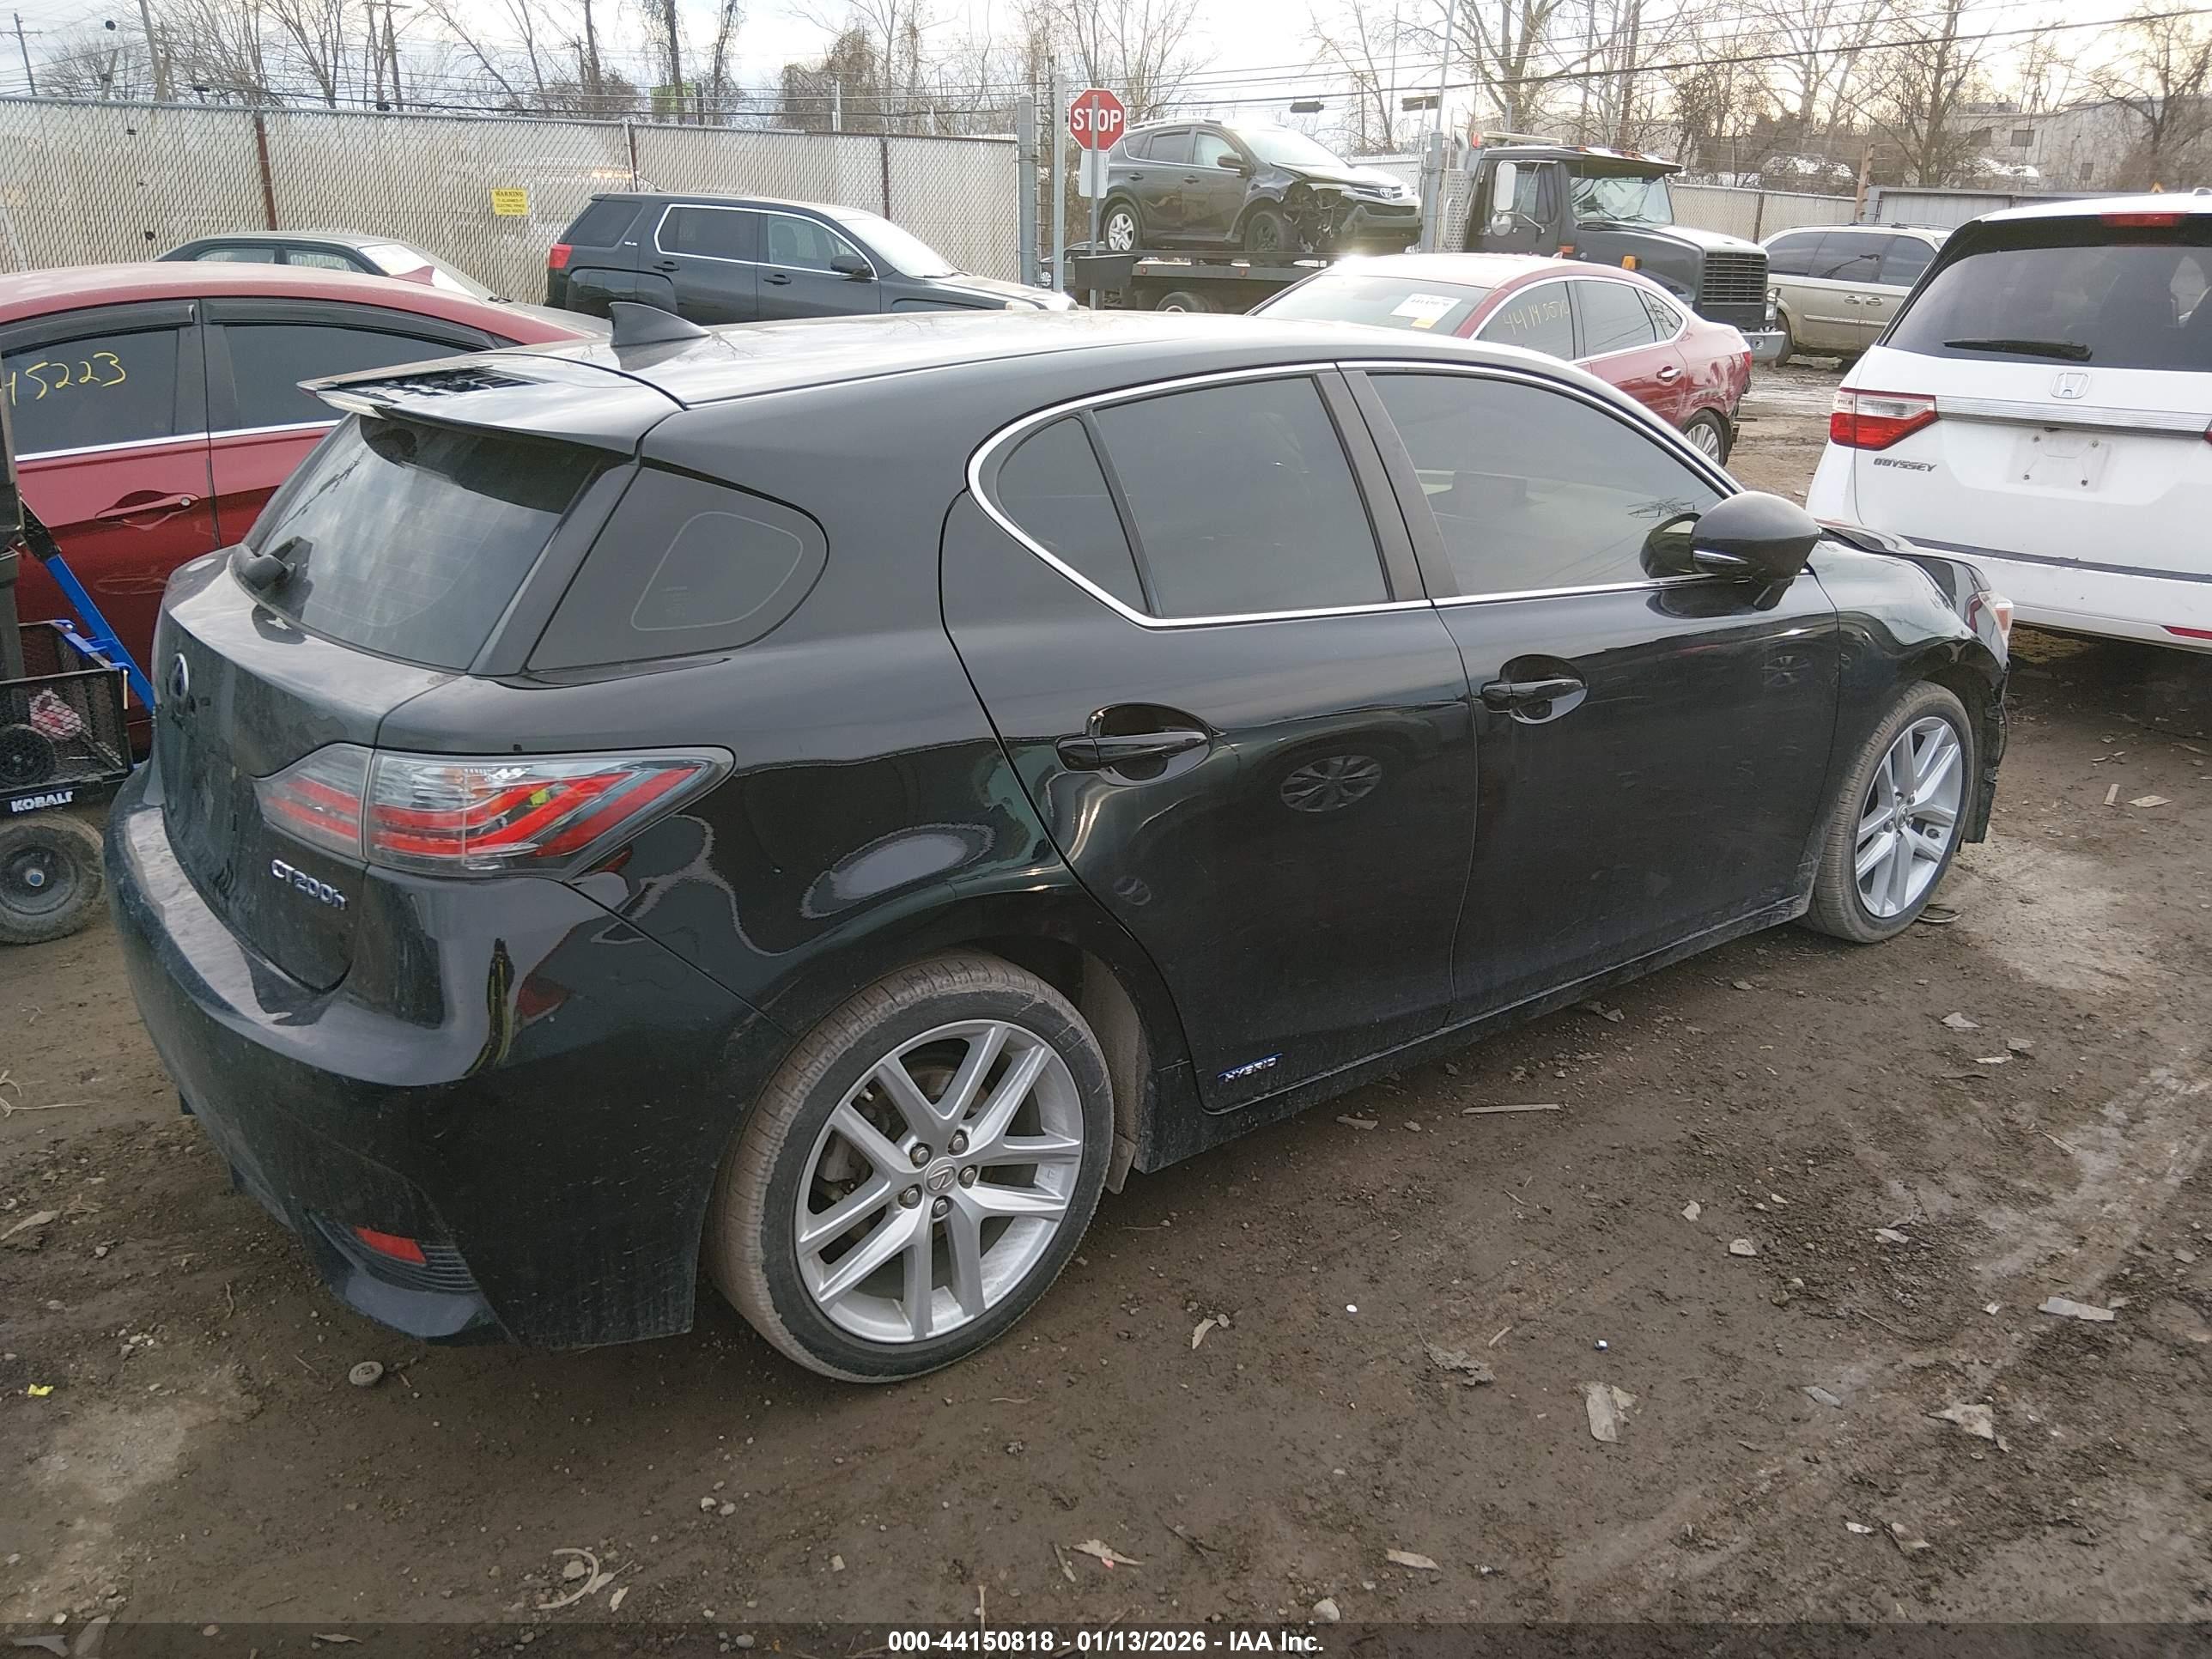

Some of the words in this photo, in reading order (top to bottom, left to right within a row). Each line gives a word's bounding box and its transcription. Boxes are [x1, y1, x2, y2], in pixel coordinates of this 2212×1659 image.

[1073, 108, 1121, 132] STOP
[1873, 458, 1937, 472] ODYSSEY
[10, 791, 74, 812] KOBALT
[271, 859, 345, 910] CT200h
[1224, 1057, 1277, 1082] HYBRID
